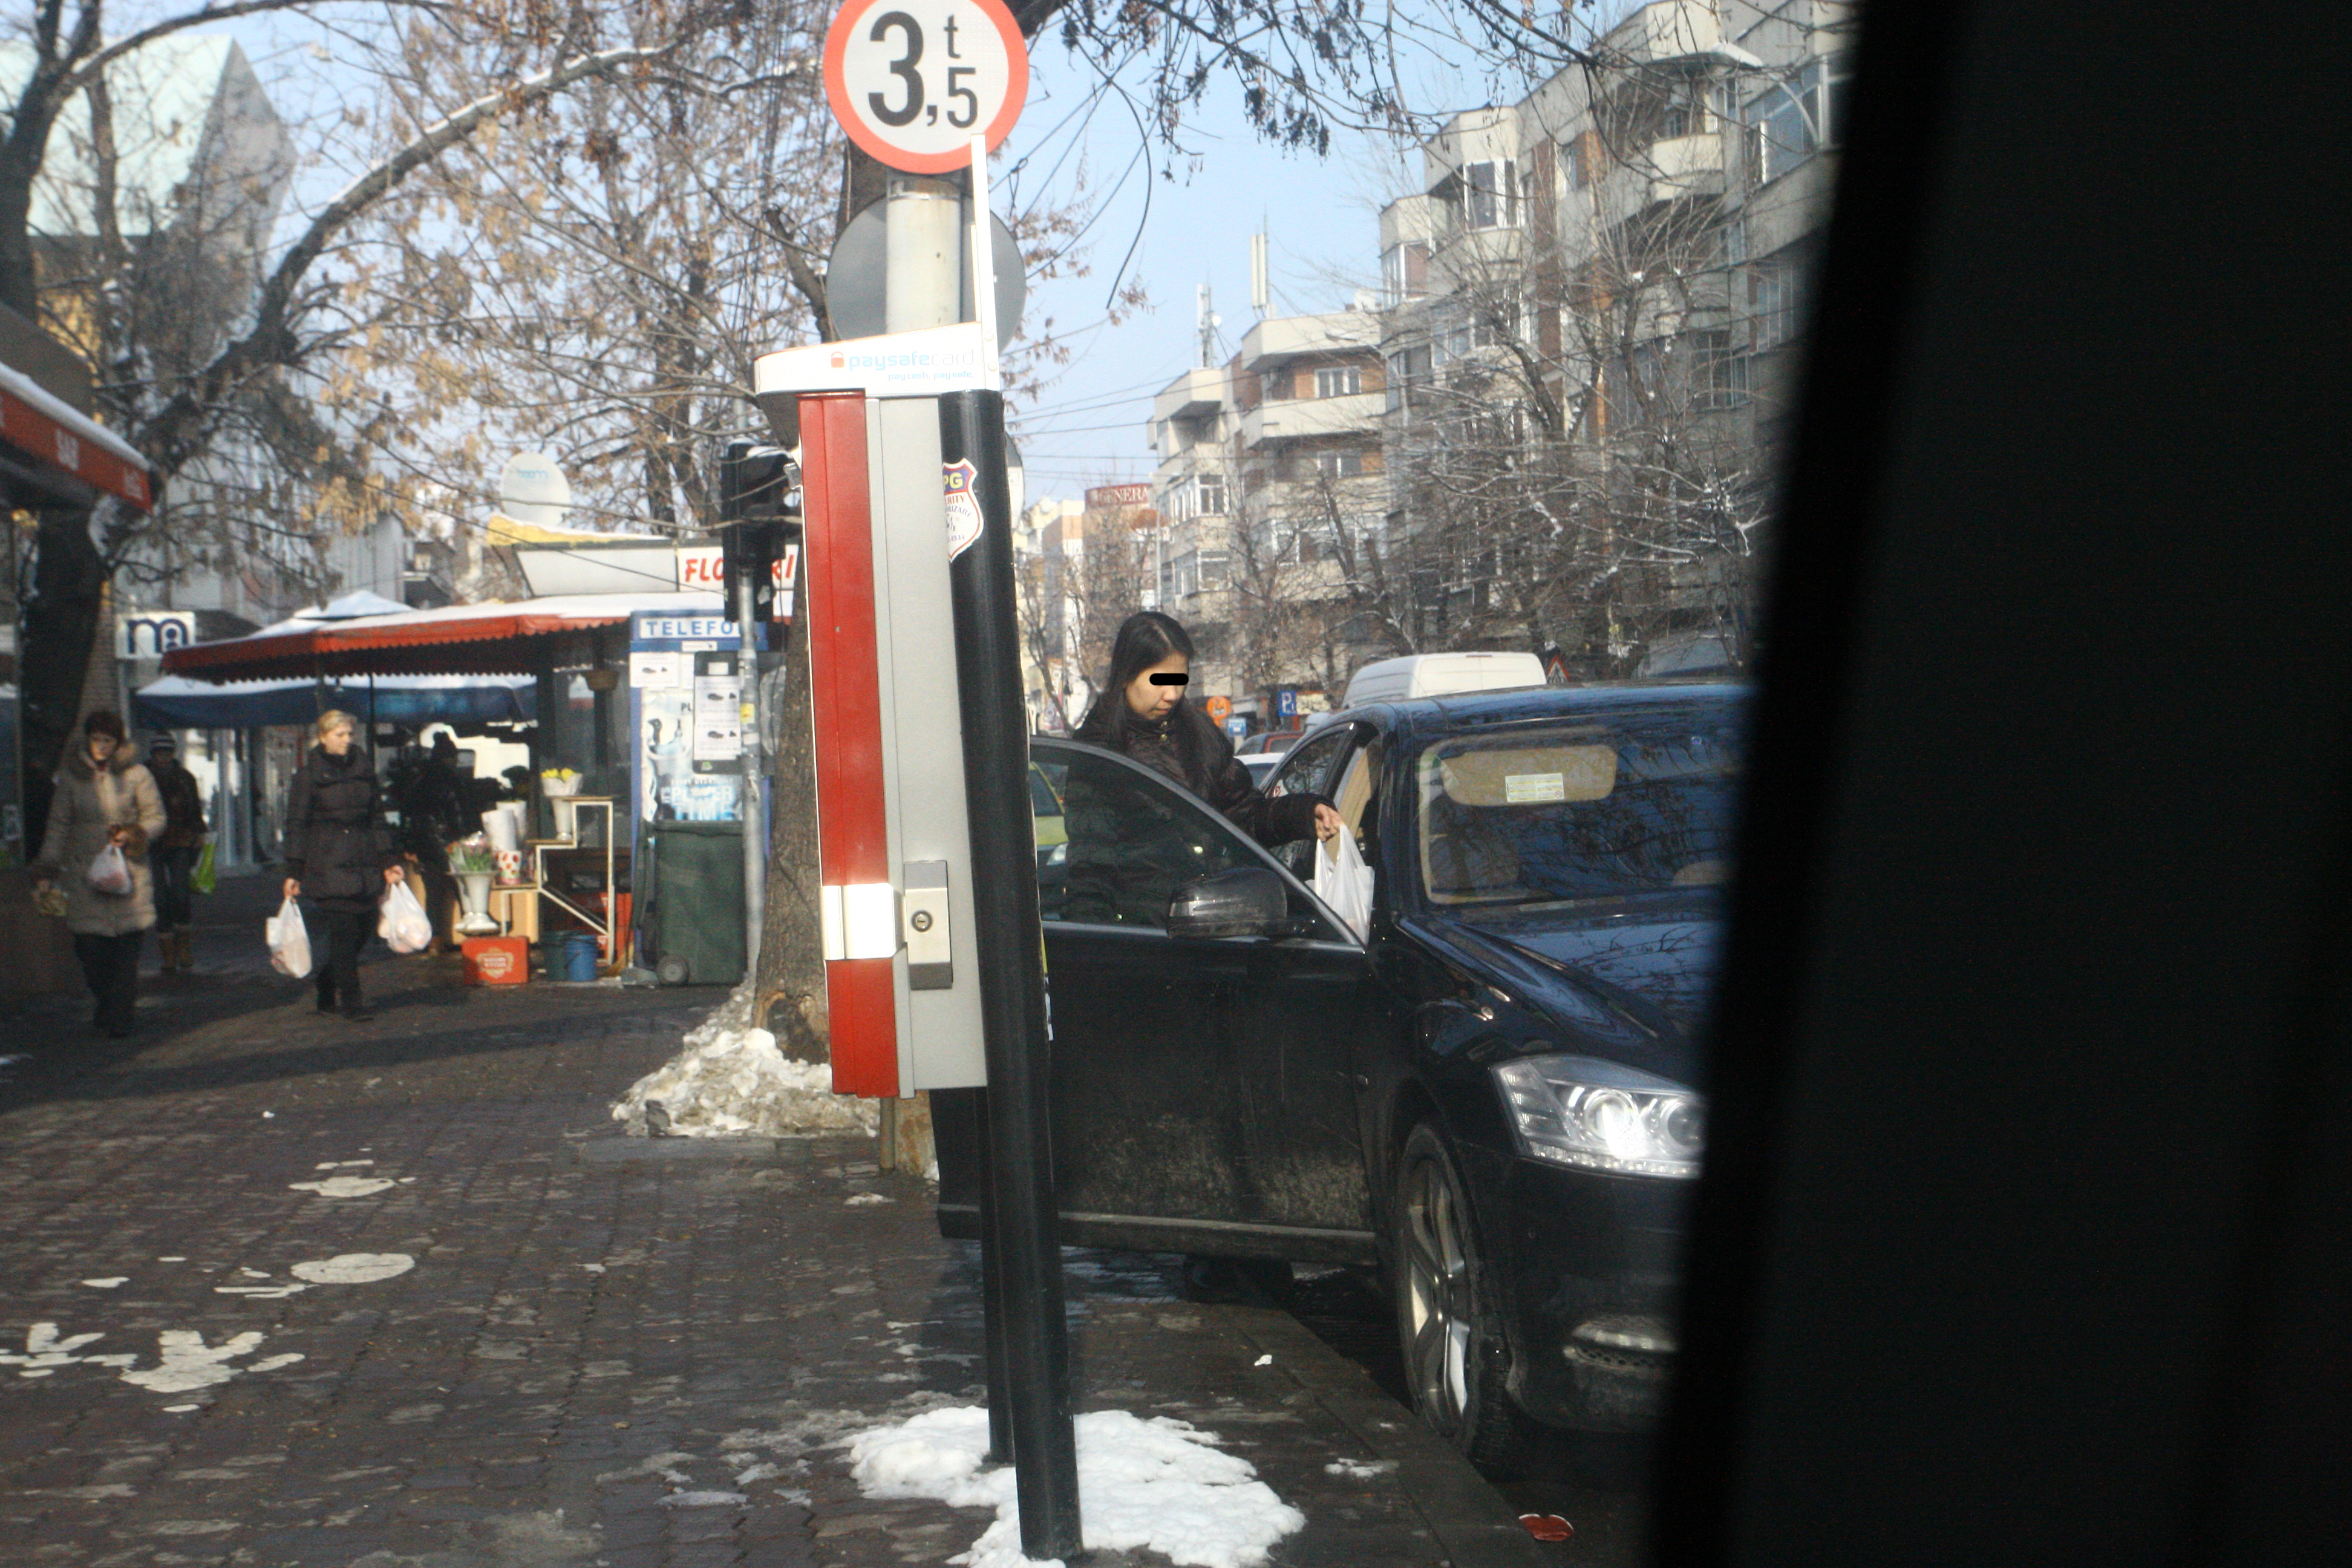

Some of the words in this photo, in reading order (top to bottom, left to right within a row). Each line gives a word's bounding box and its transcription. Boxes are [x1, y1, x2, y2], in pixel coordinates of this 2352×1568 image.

[868, 11, 978, 129] 3,5
[943, 15, 961, 59] t
[849, 350, 975, 371] paysafecard
[888, 373, 906, 382] pay
[646, 620, 739, 635] TELEFO
